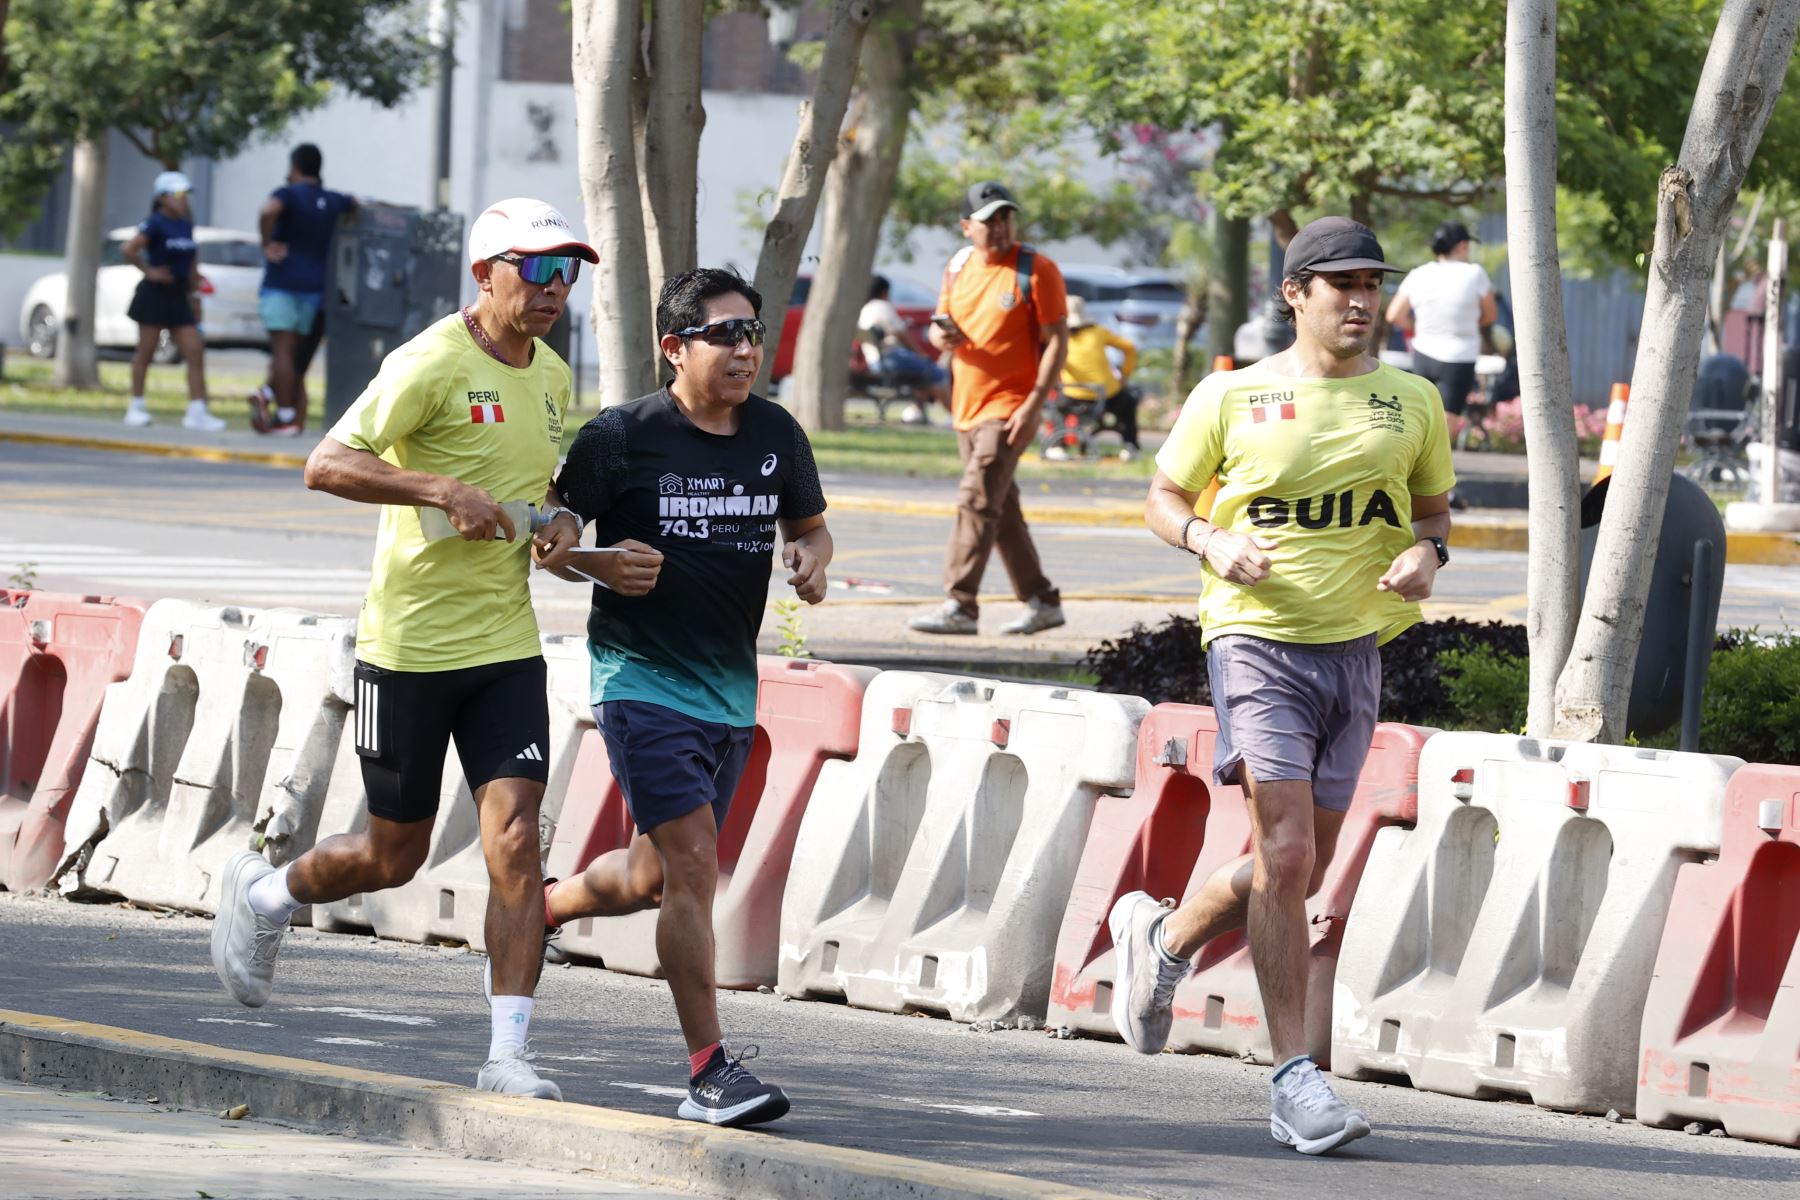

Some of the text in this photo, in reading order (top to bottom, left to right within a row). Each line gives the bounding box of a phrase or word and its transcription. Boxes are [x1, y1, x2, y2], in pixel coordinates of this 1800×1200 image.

[467, 390, 500, 403] PERU
[1249, 391, 1294, 405] PERU
[687, 478, 725, 490] XMART
[659, 485, 779, 517] IRONMAN
[1247, 489, 1402, 529] GUIA
[659, 518, 709, 538] 70.3
[711, 523, 740, 533] PERÚ
[696, 1080, 724, 1102] HOKA
